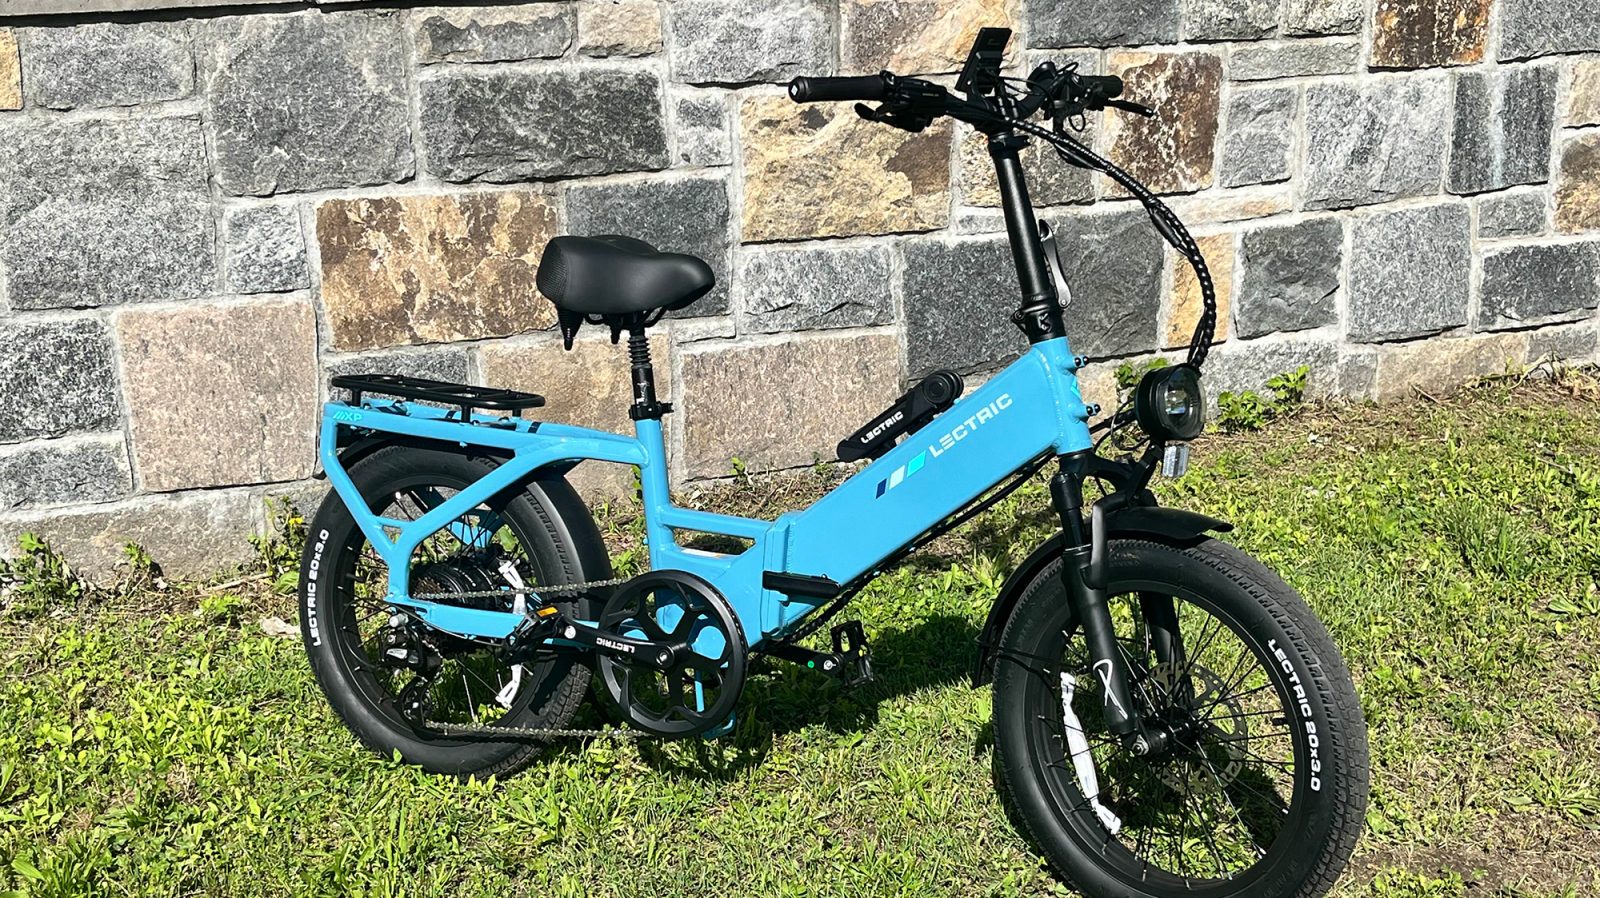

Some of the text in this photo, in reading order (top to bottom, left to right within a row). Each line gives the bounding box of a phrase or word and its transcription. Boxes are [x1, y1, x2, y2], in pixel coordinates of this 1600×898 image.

[860, 411, 904, 444] LECTRIC
[929, 393, 1013, 458] LECTRIC
[307, 529, 330, 647] LECTRIC 20x3.0
[596, 637, 636, 654] LECTRIC
[1267, 638, 1321, 792] LECTRIC 20x3.0
